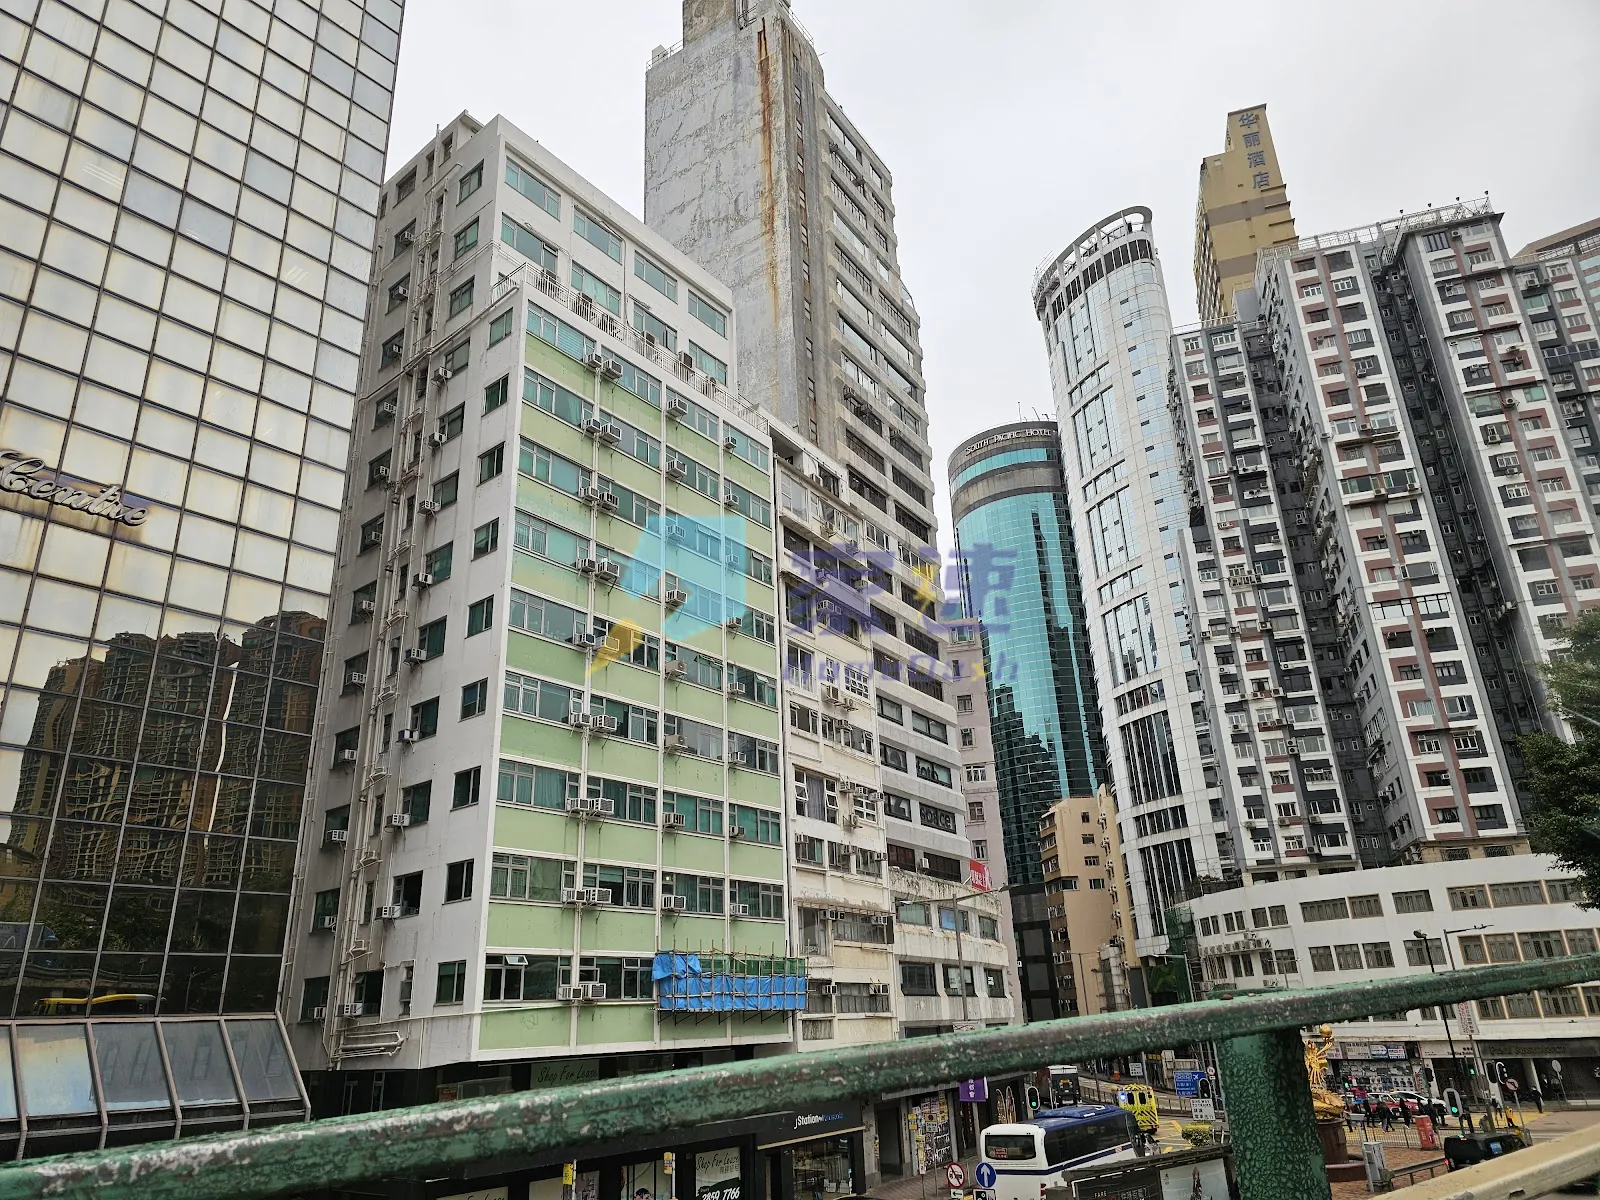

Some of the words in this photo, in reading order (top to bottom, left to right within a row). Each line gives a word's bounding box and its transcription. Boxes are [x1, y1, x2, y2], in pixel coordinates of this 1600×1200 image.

[1239, 113, 1270, 189] 华丽酒店
[965, 439, 989, 453] SOUTH
[993, 430, 1021, 443] PACIFIC
[1025, 428, 1052, 437] HOTEL
[0, 458, 148, 526] Centre
[538, 1066, 558, 1086] Shop
[560, 1064, 575, 1081] For
[576, 1064, 598, 1080] Lease
[696, 1156, 711, 1174] Shop
